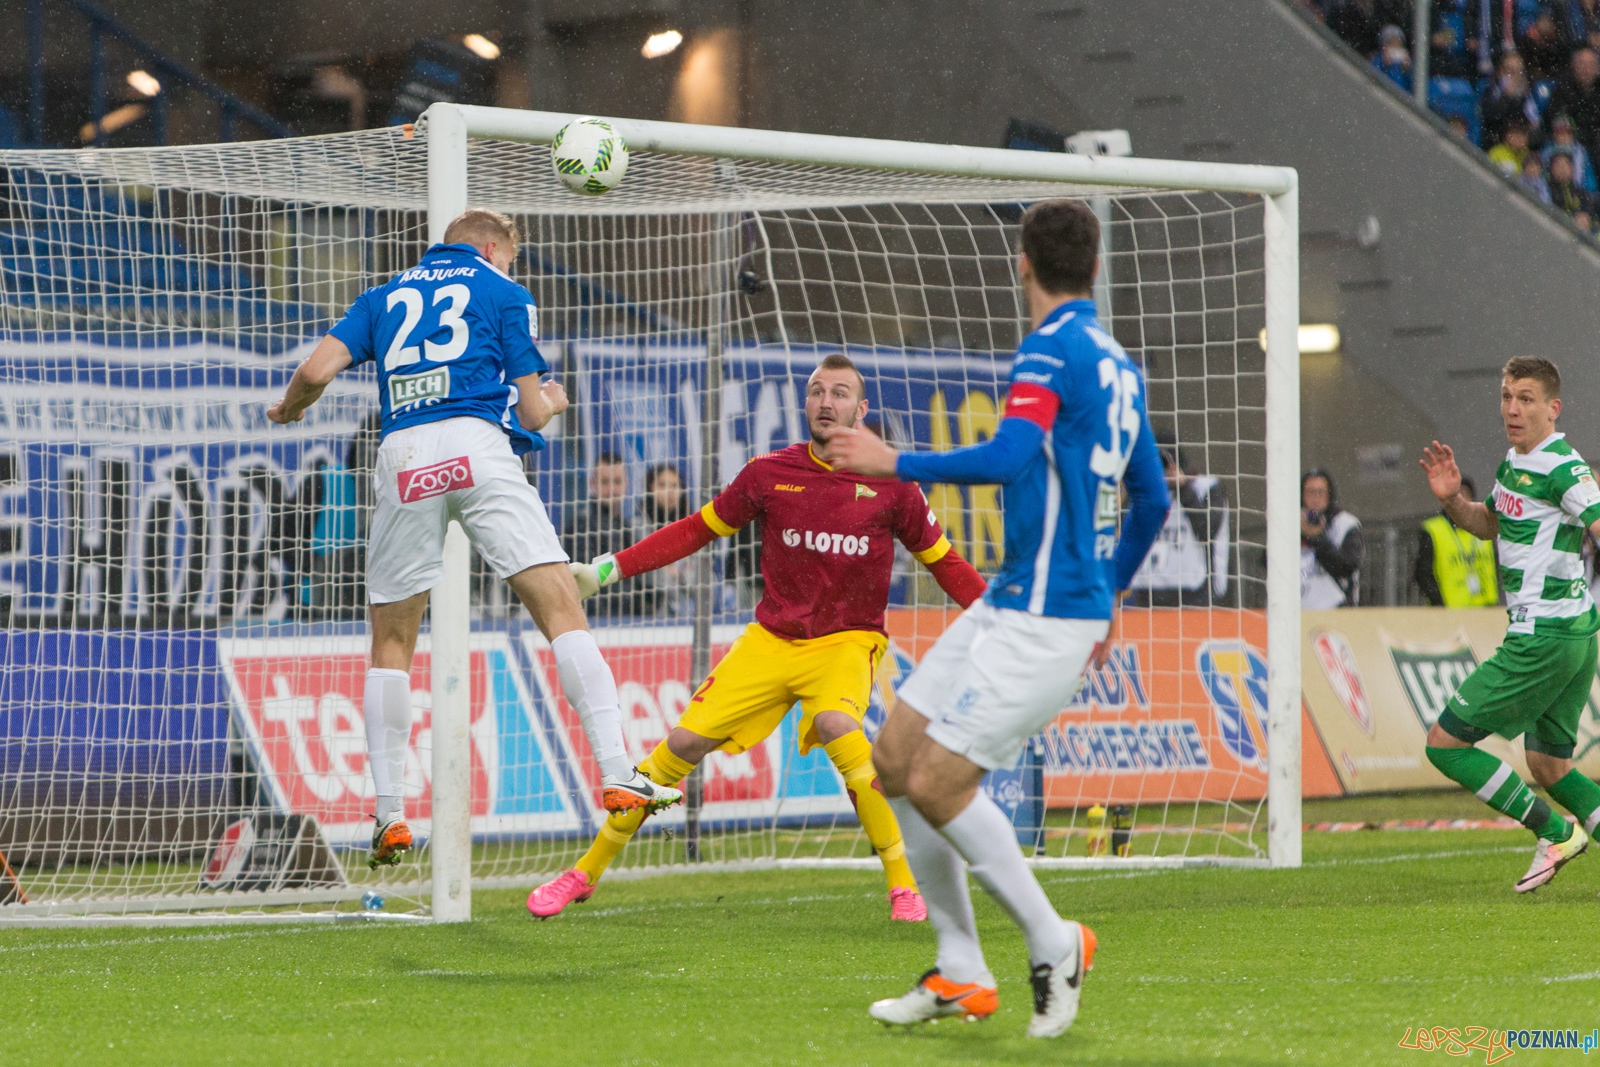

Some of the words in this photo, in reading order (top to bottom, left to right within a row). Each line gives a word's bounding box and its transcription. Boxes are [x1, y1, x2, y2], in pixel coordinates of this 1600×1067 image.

[400, 267, 478, 284] ARAJUURI
[384, 283, 471, 372] 23
[395, 375, 442, 400] LECH
[1089, 357, 1141, 480] 35
[805, 530, 869, 556] LOTOS
